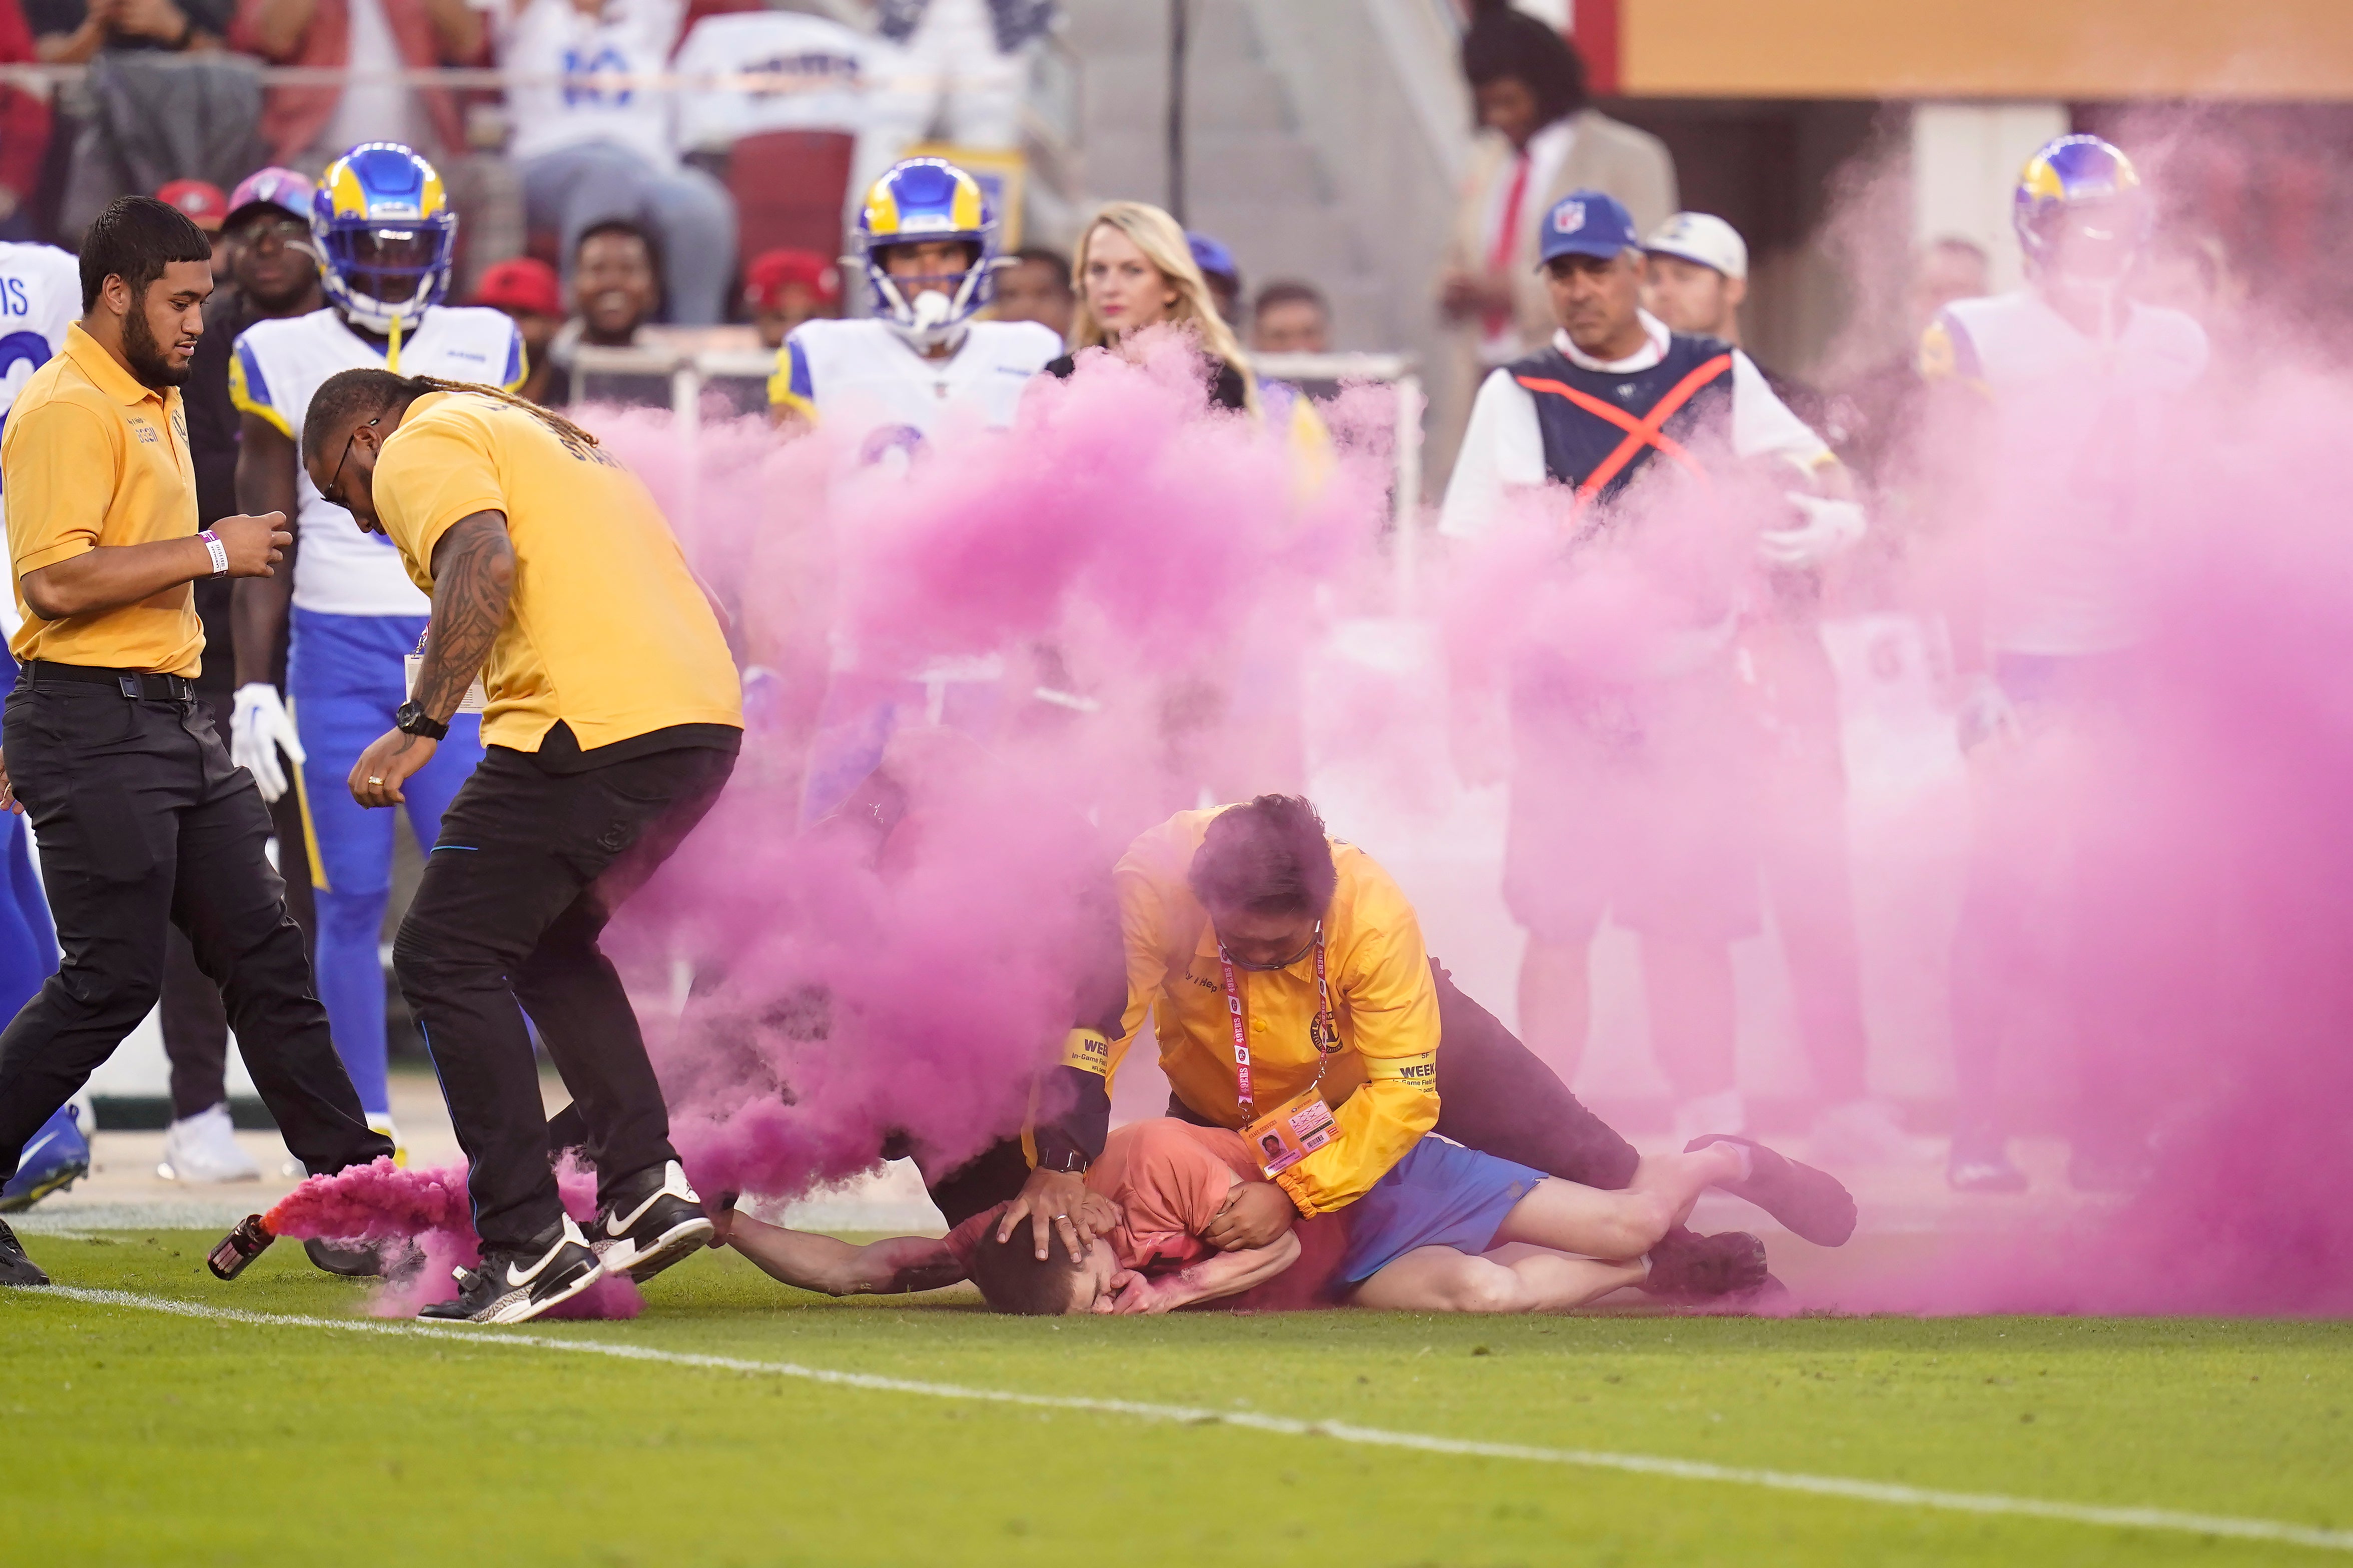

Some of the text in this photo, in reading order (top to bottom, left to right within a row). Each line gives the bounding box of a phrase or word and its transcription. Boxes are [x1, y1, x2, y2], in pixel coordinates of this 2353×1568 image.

[1224, 967, 1236, 993] 49ERS
[1234, 1017, 1244, 1043] 49ERS
[1084, 1038, 1108, 1057] WEE
[1072, 1052, 1099, 1063] In-Game
[1399, 1062, 1435, 1079] WEEK
